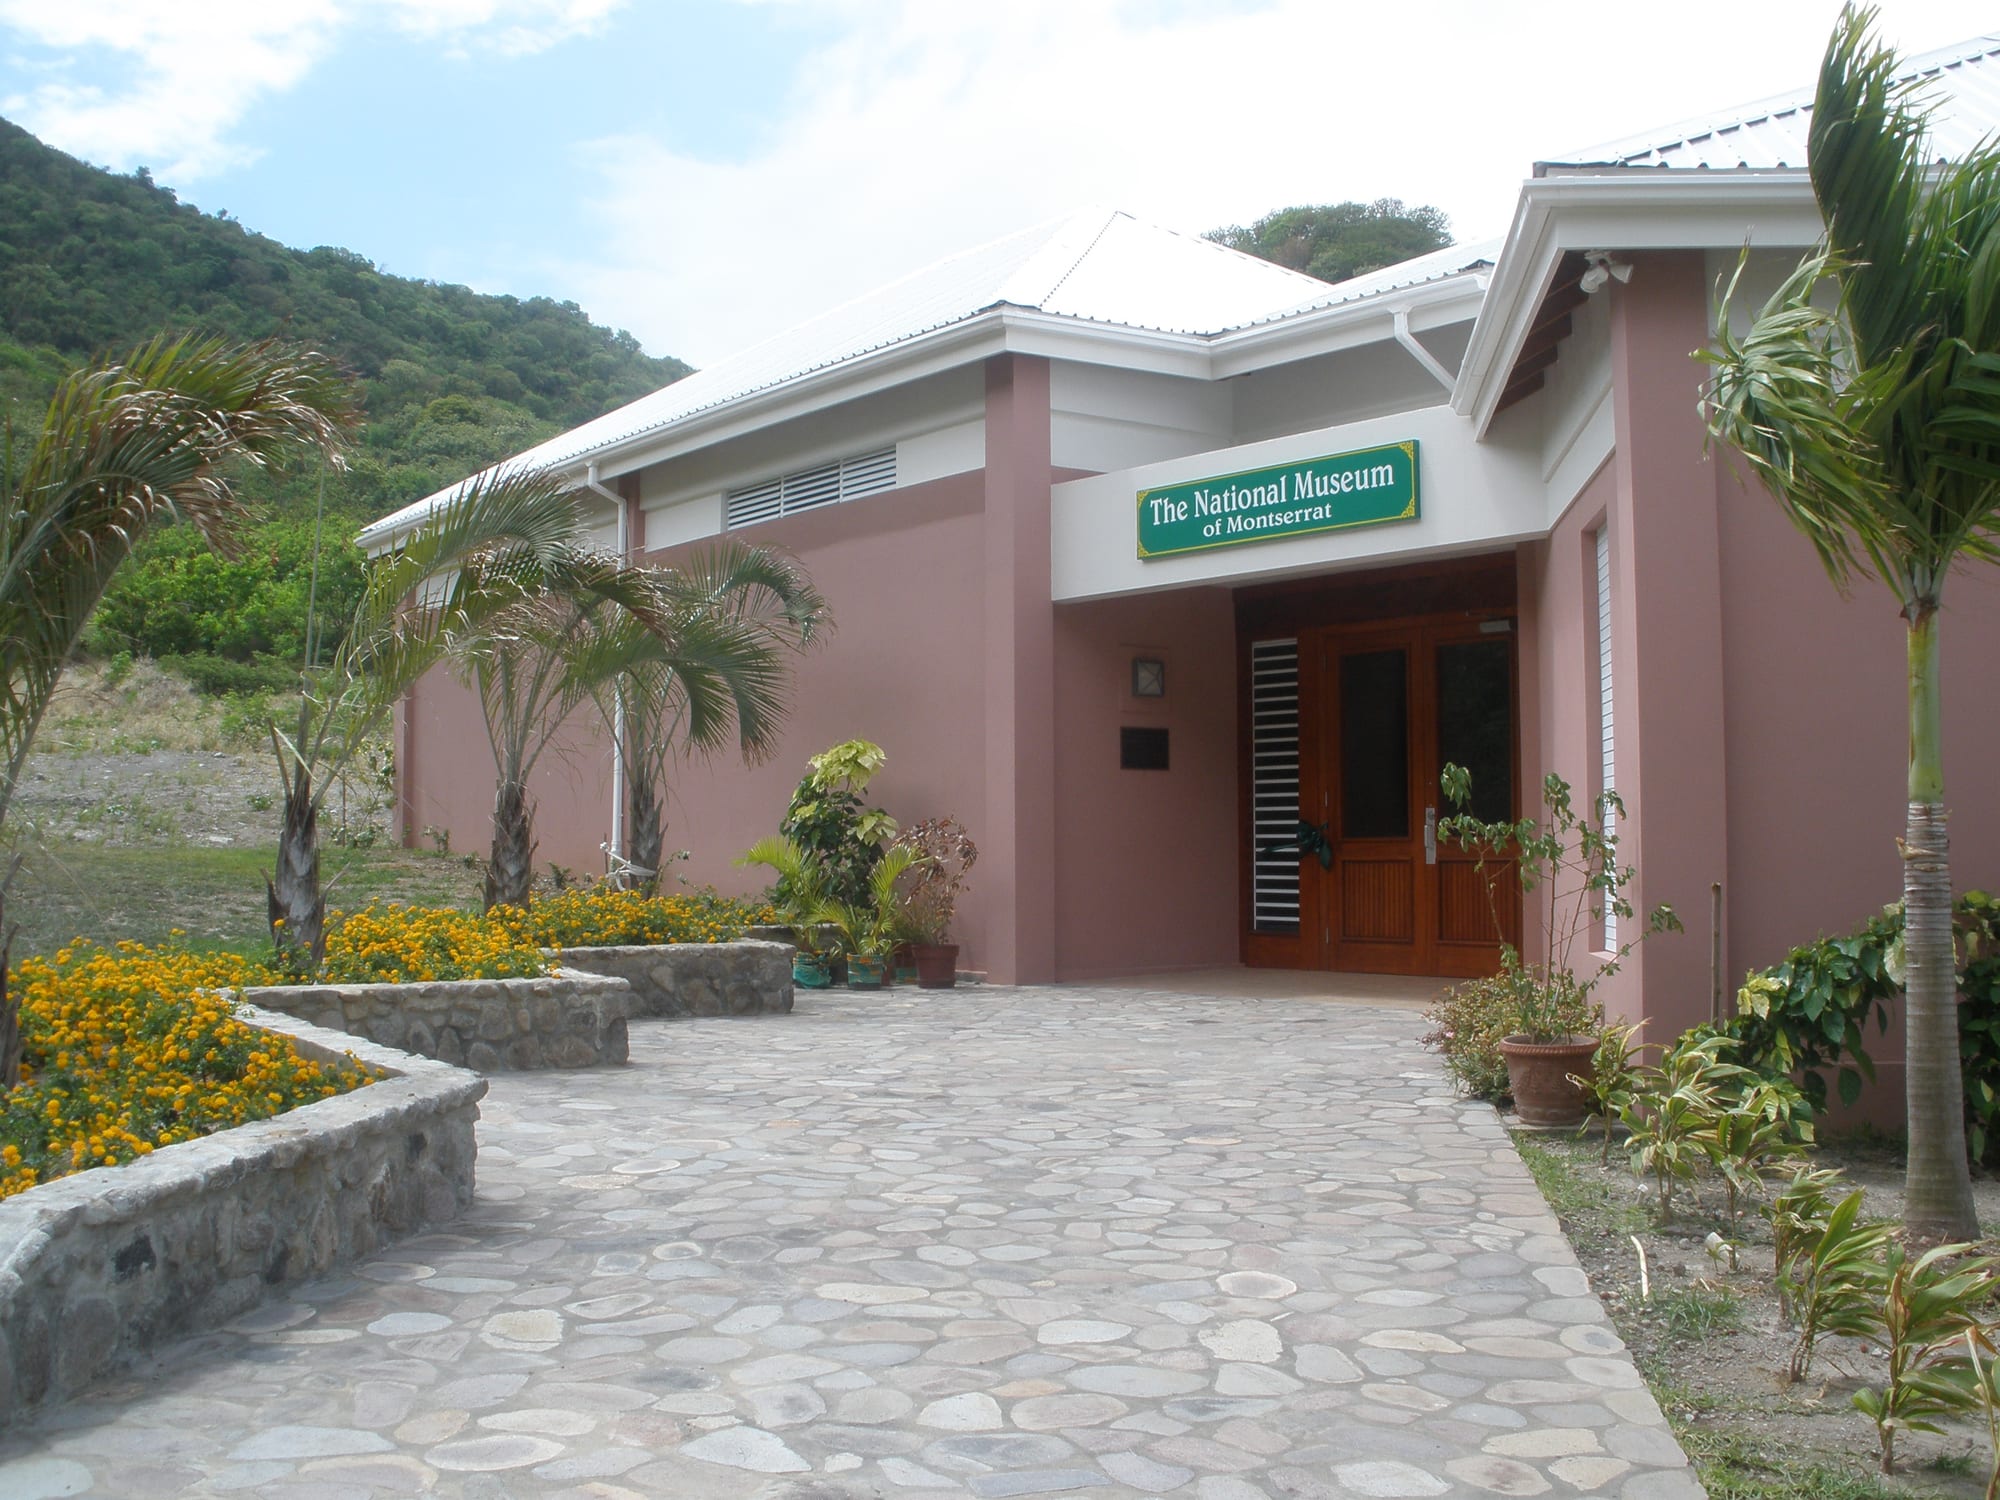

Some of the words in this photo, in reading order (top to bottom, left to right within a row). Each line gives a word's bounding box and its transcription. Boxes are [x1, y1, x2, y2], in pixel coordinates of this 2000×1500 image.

[1150, 498, 1188, 526] The
[1193, 475, 1287, 518] National
[1294, 463, 1394, 500] Museum
[1203, 518, 1222, 537] of
[1226, 503, 1332, 534] Montserrat
